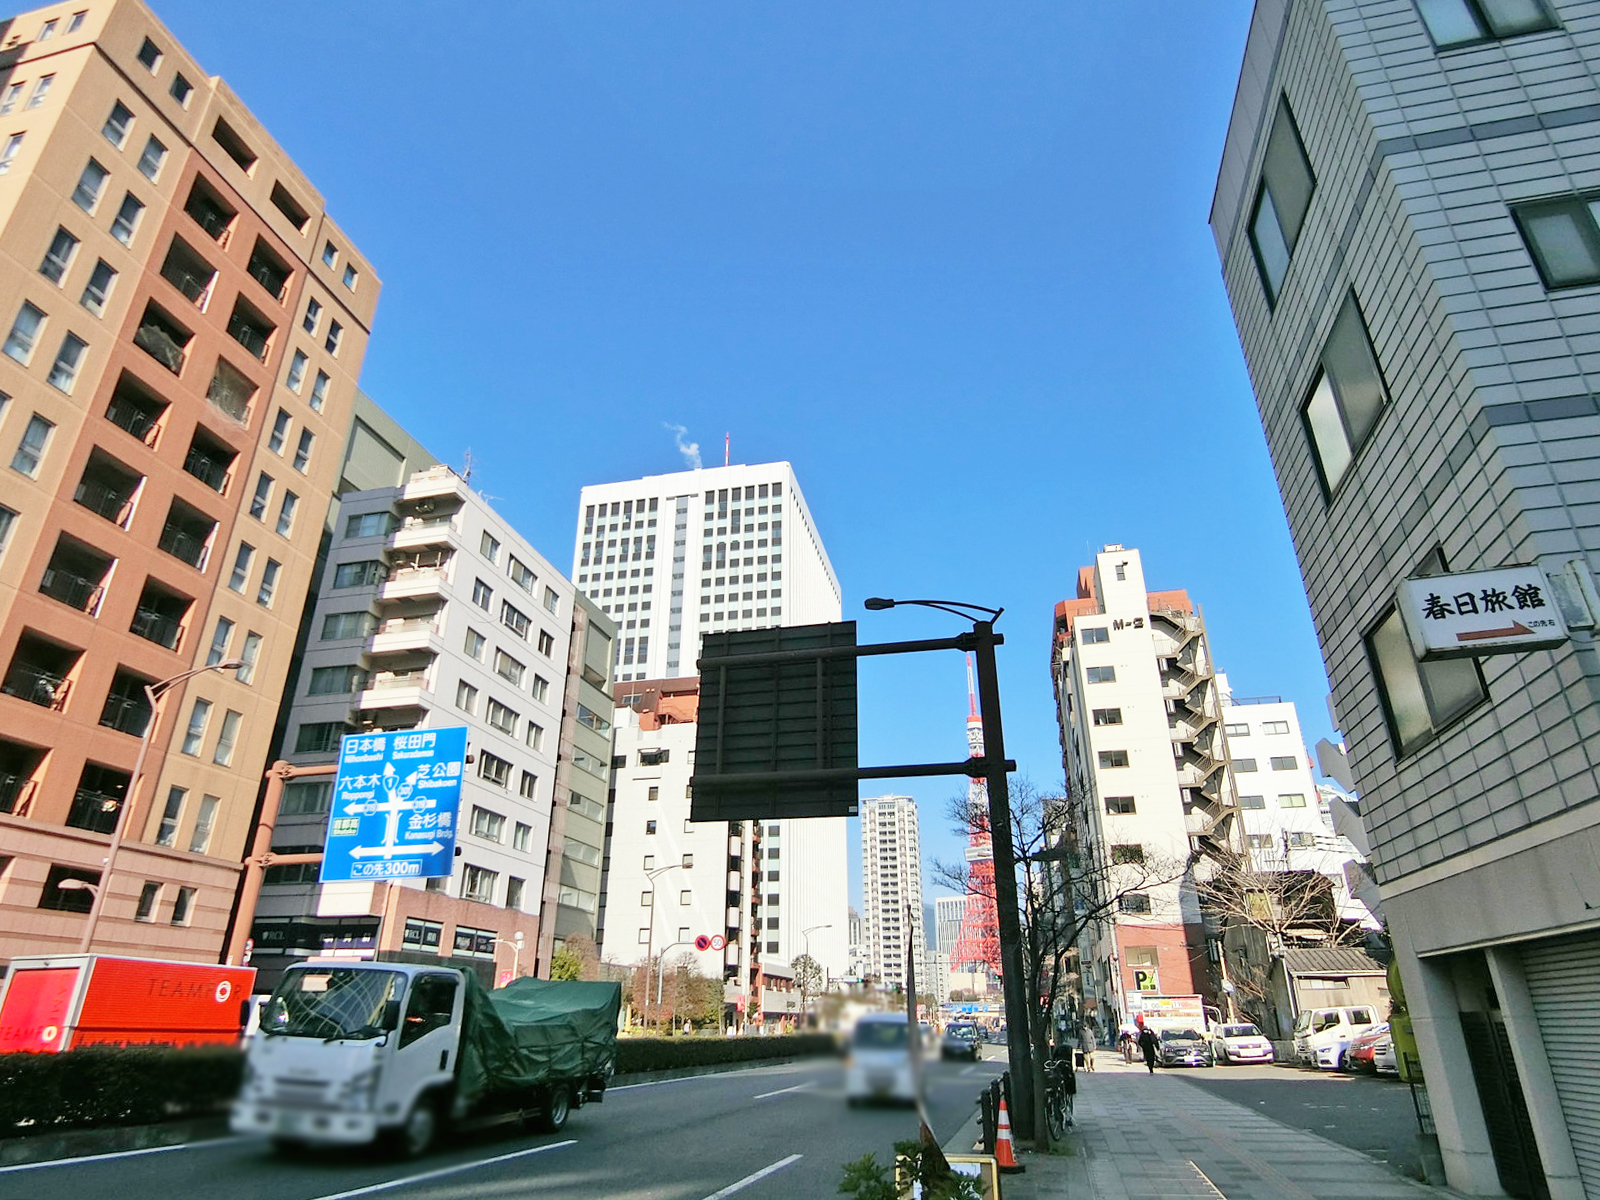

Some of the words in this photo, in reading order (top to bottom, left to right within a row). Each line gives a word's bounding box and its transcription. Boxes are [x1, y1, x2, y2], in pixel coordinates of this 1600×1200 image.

[1422, 584, 1546, 620] 春日旅館
[345, 737, 386, 754] 日本橋
[393, 733, 436, 749] 桜田門
[417, 762, 461, 779] 芝公園
[339, 773, 382, 790] 六本木
[417, 779, 457, 789] Shibakoen
[408, 812, 452, 830] 金杉橋
[352, 862, 419, 876] この先300m
[713, 938, 722, 947] 50
[1135, 971, 1147, 990] P
